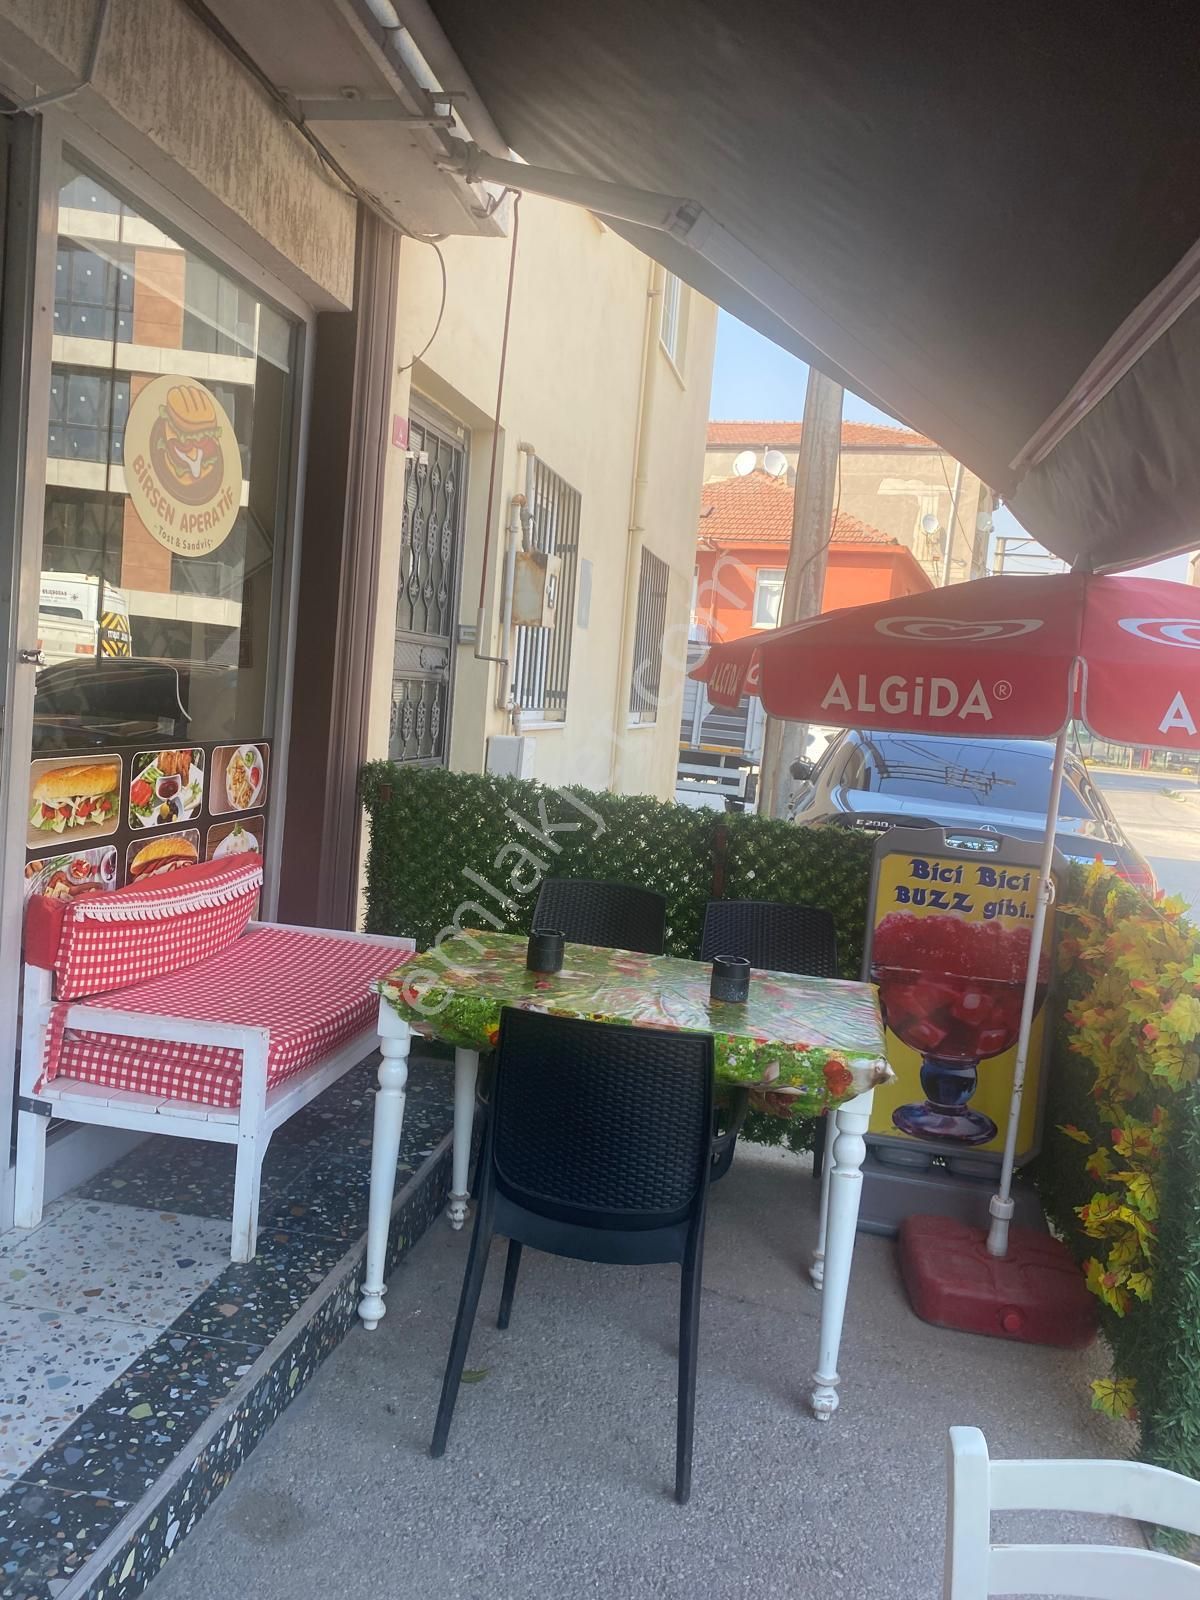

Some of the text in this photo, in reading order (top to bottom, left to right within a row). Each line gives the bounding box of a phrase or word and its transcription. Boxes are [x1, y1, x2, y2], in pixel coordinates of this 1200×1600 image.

[132, 454, 233, 533] BİRSEN APERATİF
[158, 525, 174, 545] Tost
[175, 537, 182, 547] &
[910, 859, 1031, 891] Bici Bici
[894, 886, 974, 912] BUZZ
